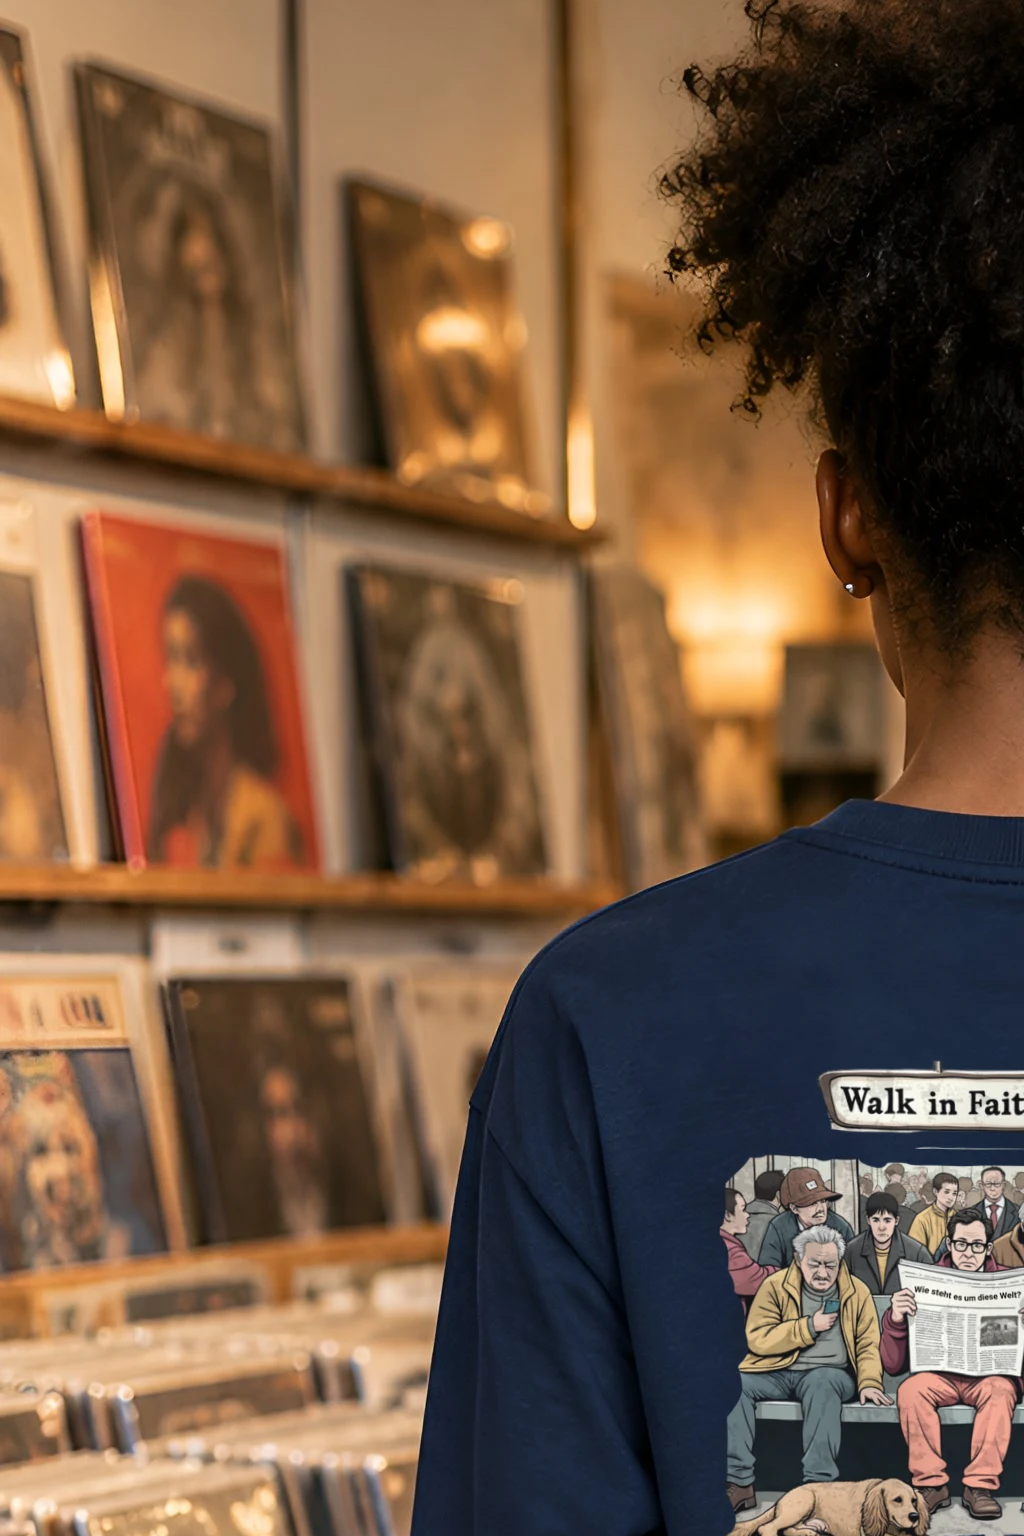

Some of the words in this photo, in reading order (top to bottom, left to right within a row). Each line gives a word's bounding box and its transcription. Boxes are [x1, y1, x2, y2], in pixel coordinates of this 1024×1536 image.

[840, 1085, 917, 1115] Walk
[928, 1090, 957, 1116] in
[914, 1285, 930, 1294] Wie
[931, 1288, 952, 1299] steht
[977, 1293, 998, 1301] diese
[999, 1291, 1021, 1299] Welt?
